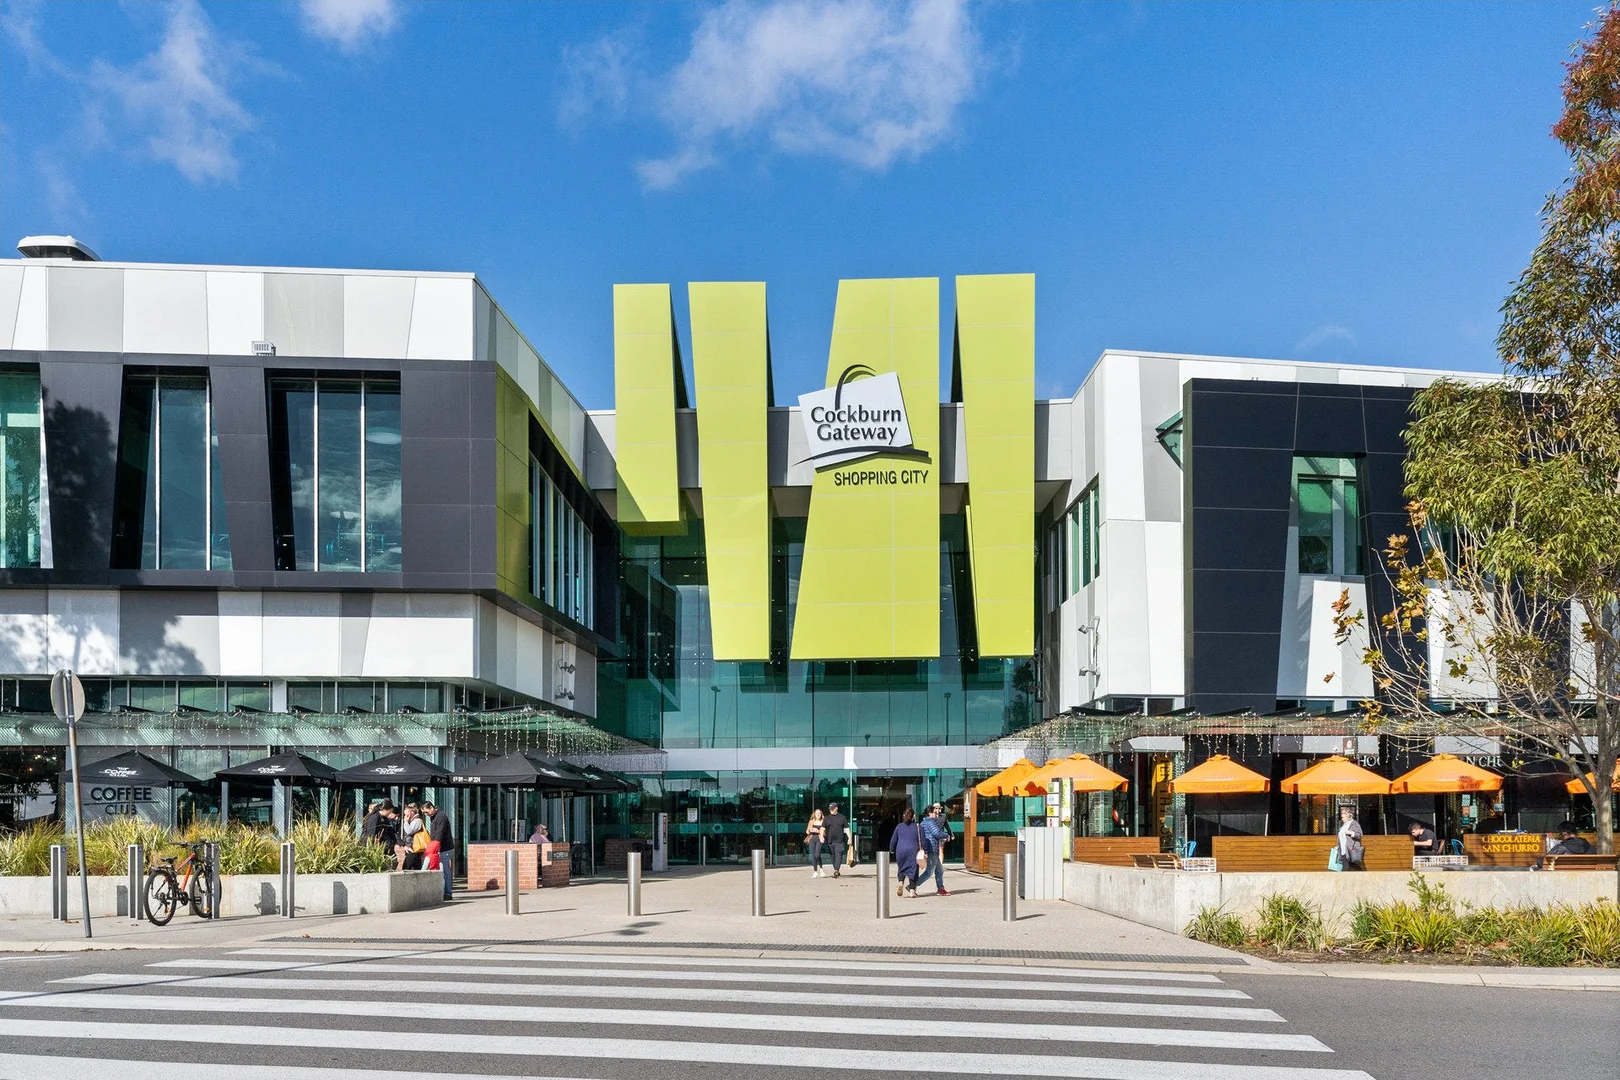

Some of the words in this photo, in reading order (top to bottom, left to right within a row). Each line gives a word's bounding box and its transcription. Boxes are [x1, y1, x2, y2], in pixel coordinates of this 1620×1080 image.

[810, 404, 902, 424] Cockburn
[816, 423, 898, 445] Gateway
[834, 471, 897, 487] SHOPPING
[901, 470, 929, 484] CITY
[90, 787, 152, 801] COFFEE
[105, 804, 138, 816] CLUB
[1482, 844, 1500, 853] SAN
[1502, 843, 1540, 852] CHURRO
